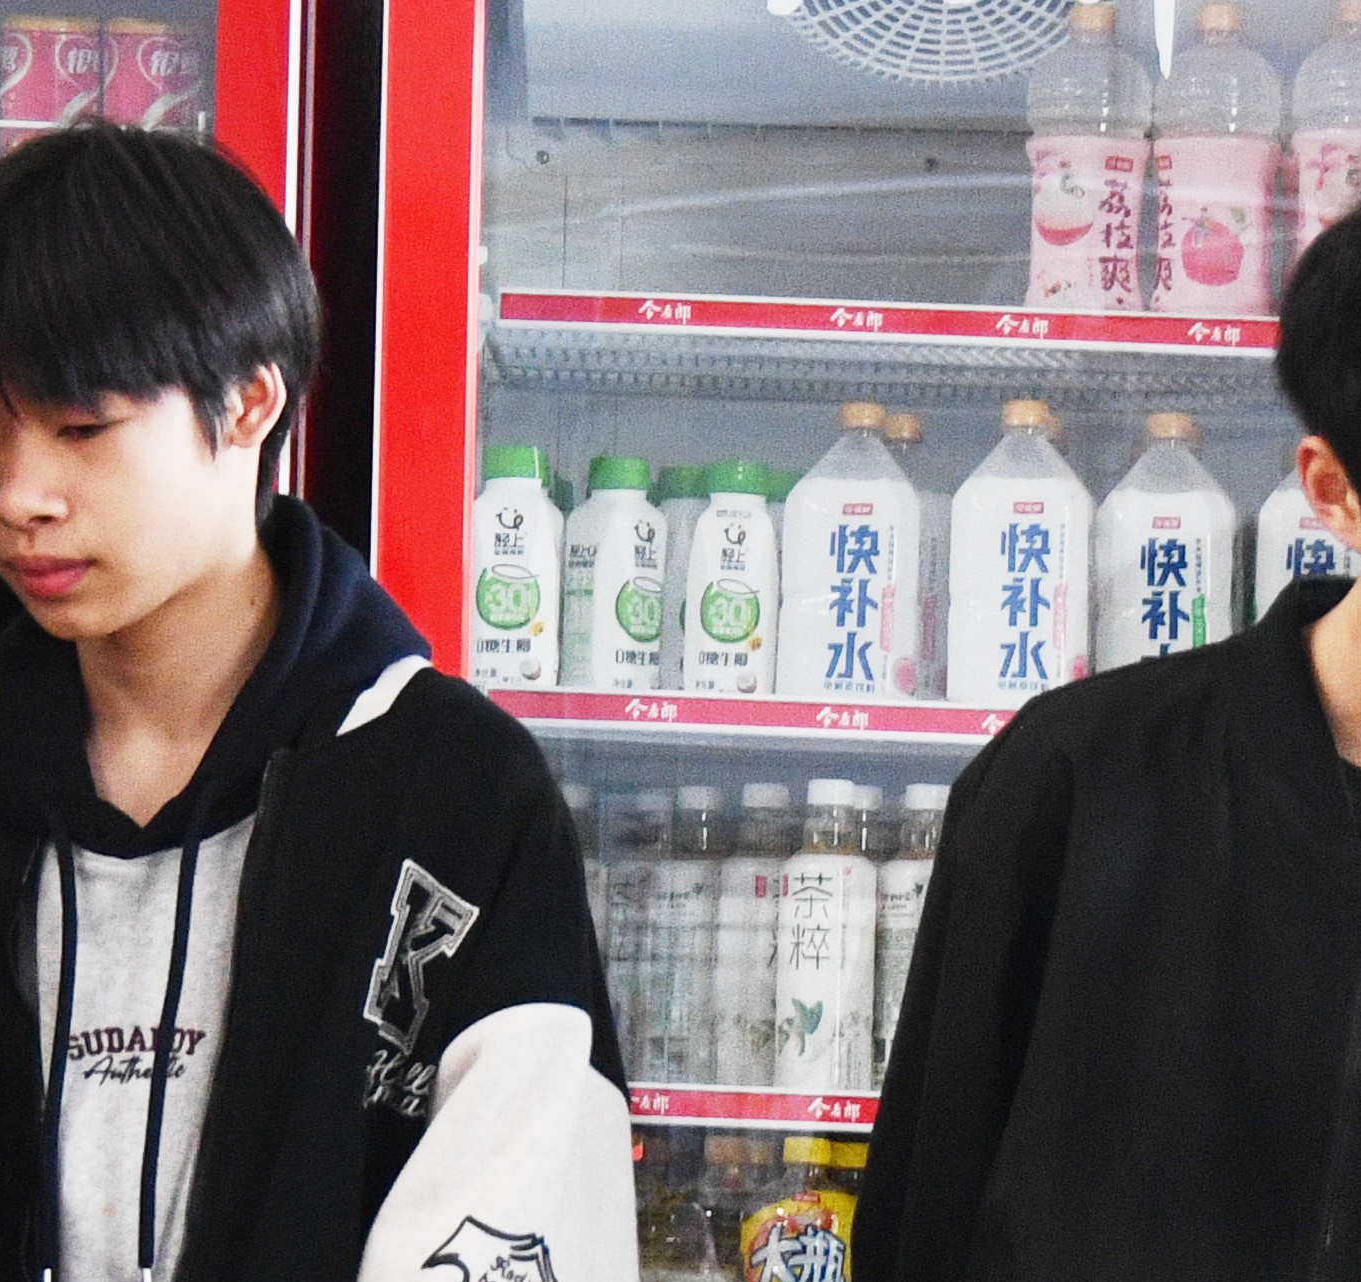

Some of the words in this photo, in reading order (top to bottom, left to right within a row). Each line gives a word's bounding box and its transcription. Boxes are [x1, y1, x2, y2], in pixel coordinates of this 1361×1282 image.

[825, 523, 880, 681] 快补水
[998, 522, 1051, 681] 快补水
[1140, 537, 1190, 656] 快补
[789, 872, 834, 971] 茶粹
